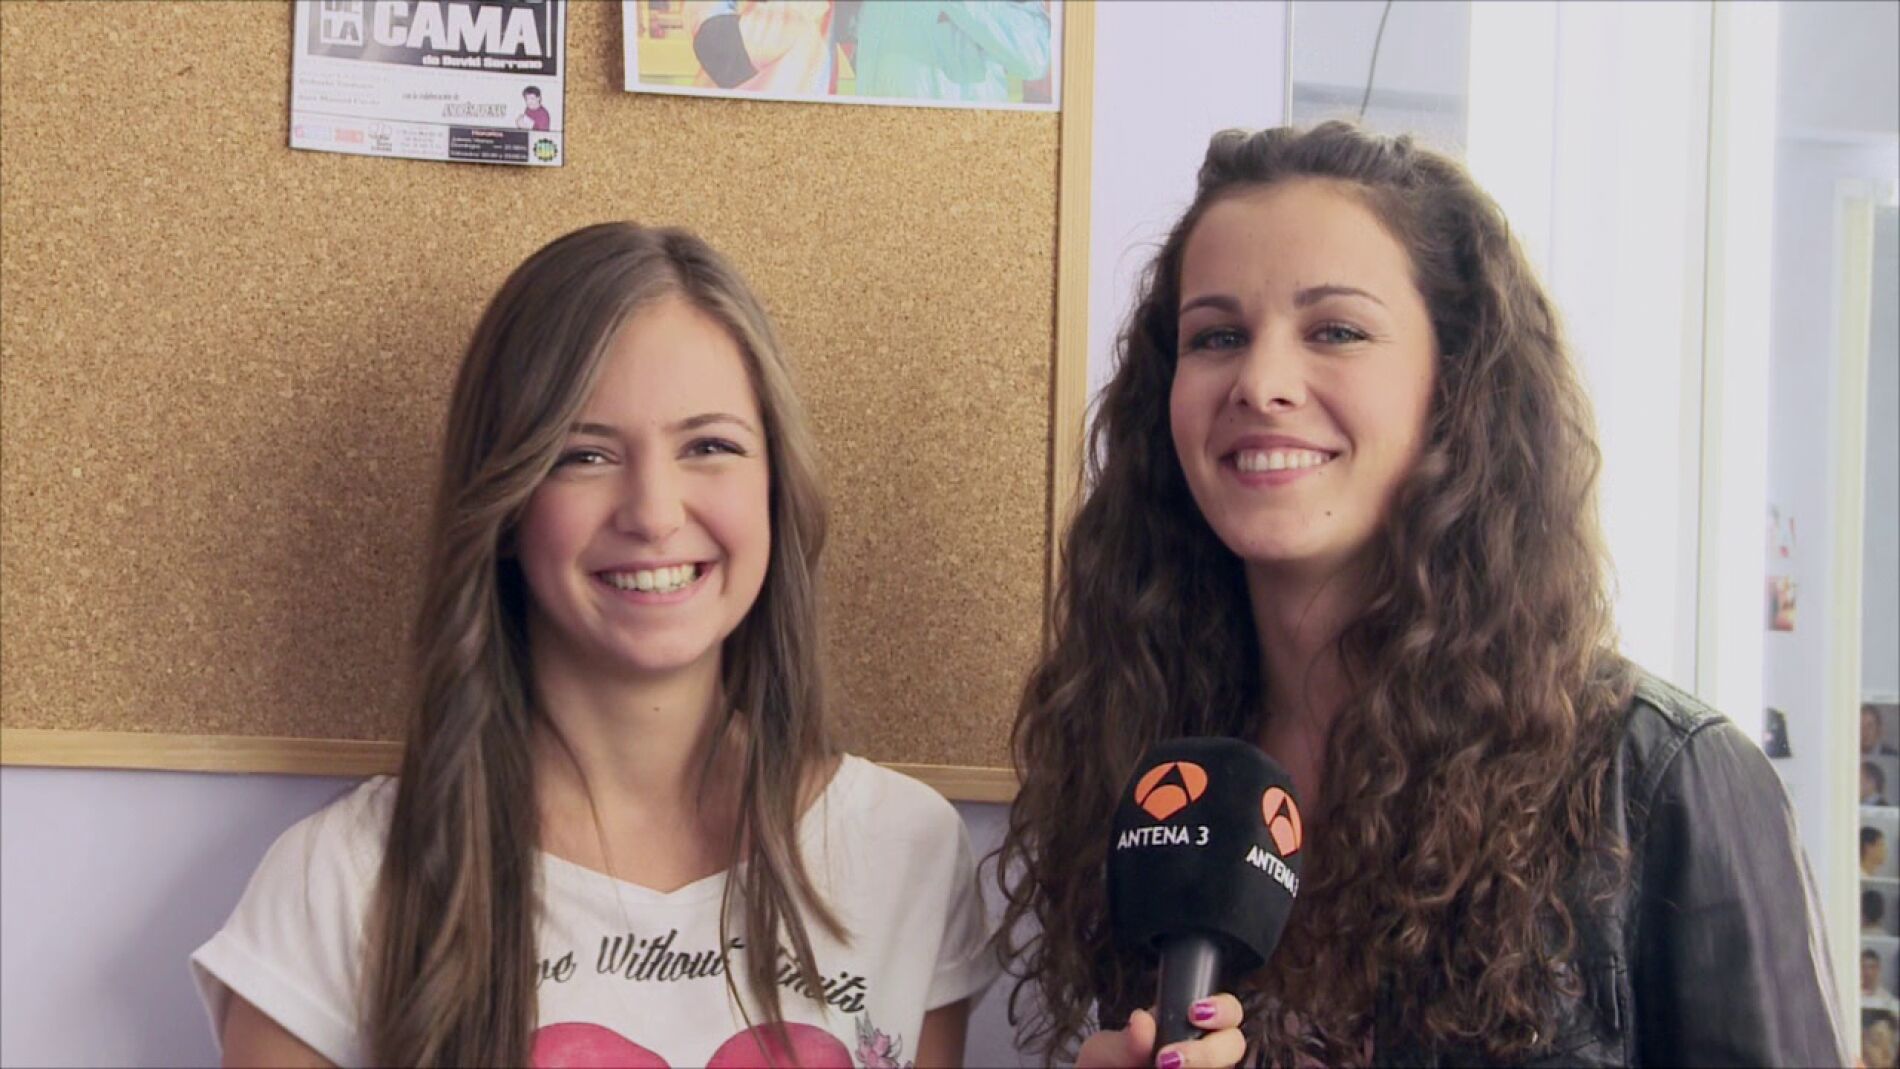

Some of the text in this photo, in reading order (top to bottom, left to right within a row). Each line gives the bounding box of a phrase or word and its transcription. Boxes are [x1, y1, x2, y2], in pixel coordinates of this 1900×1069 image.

[322, 19, 360, 41] LA
[373, 1, 542, 56] CAMA
[442, 55, 481, 68] David
[1117, 825, 1210, 850] ANTENA 3
[595, 929, 746, 982] Without
